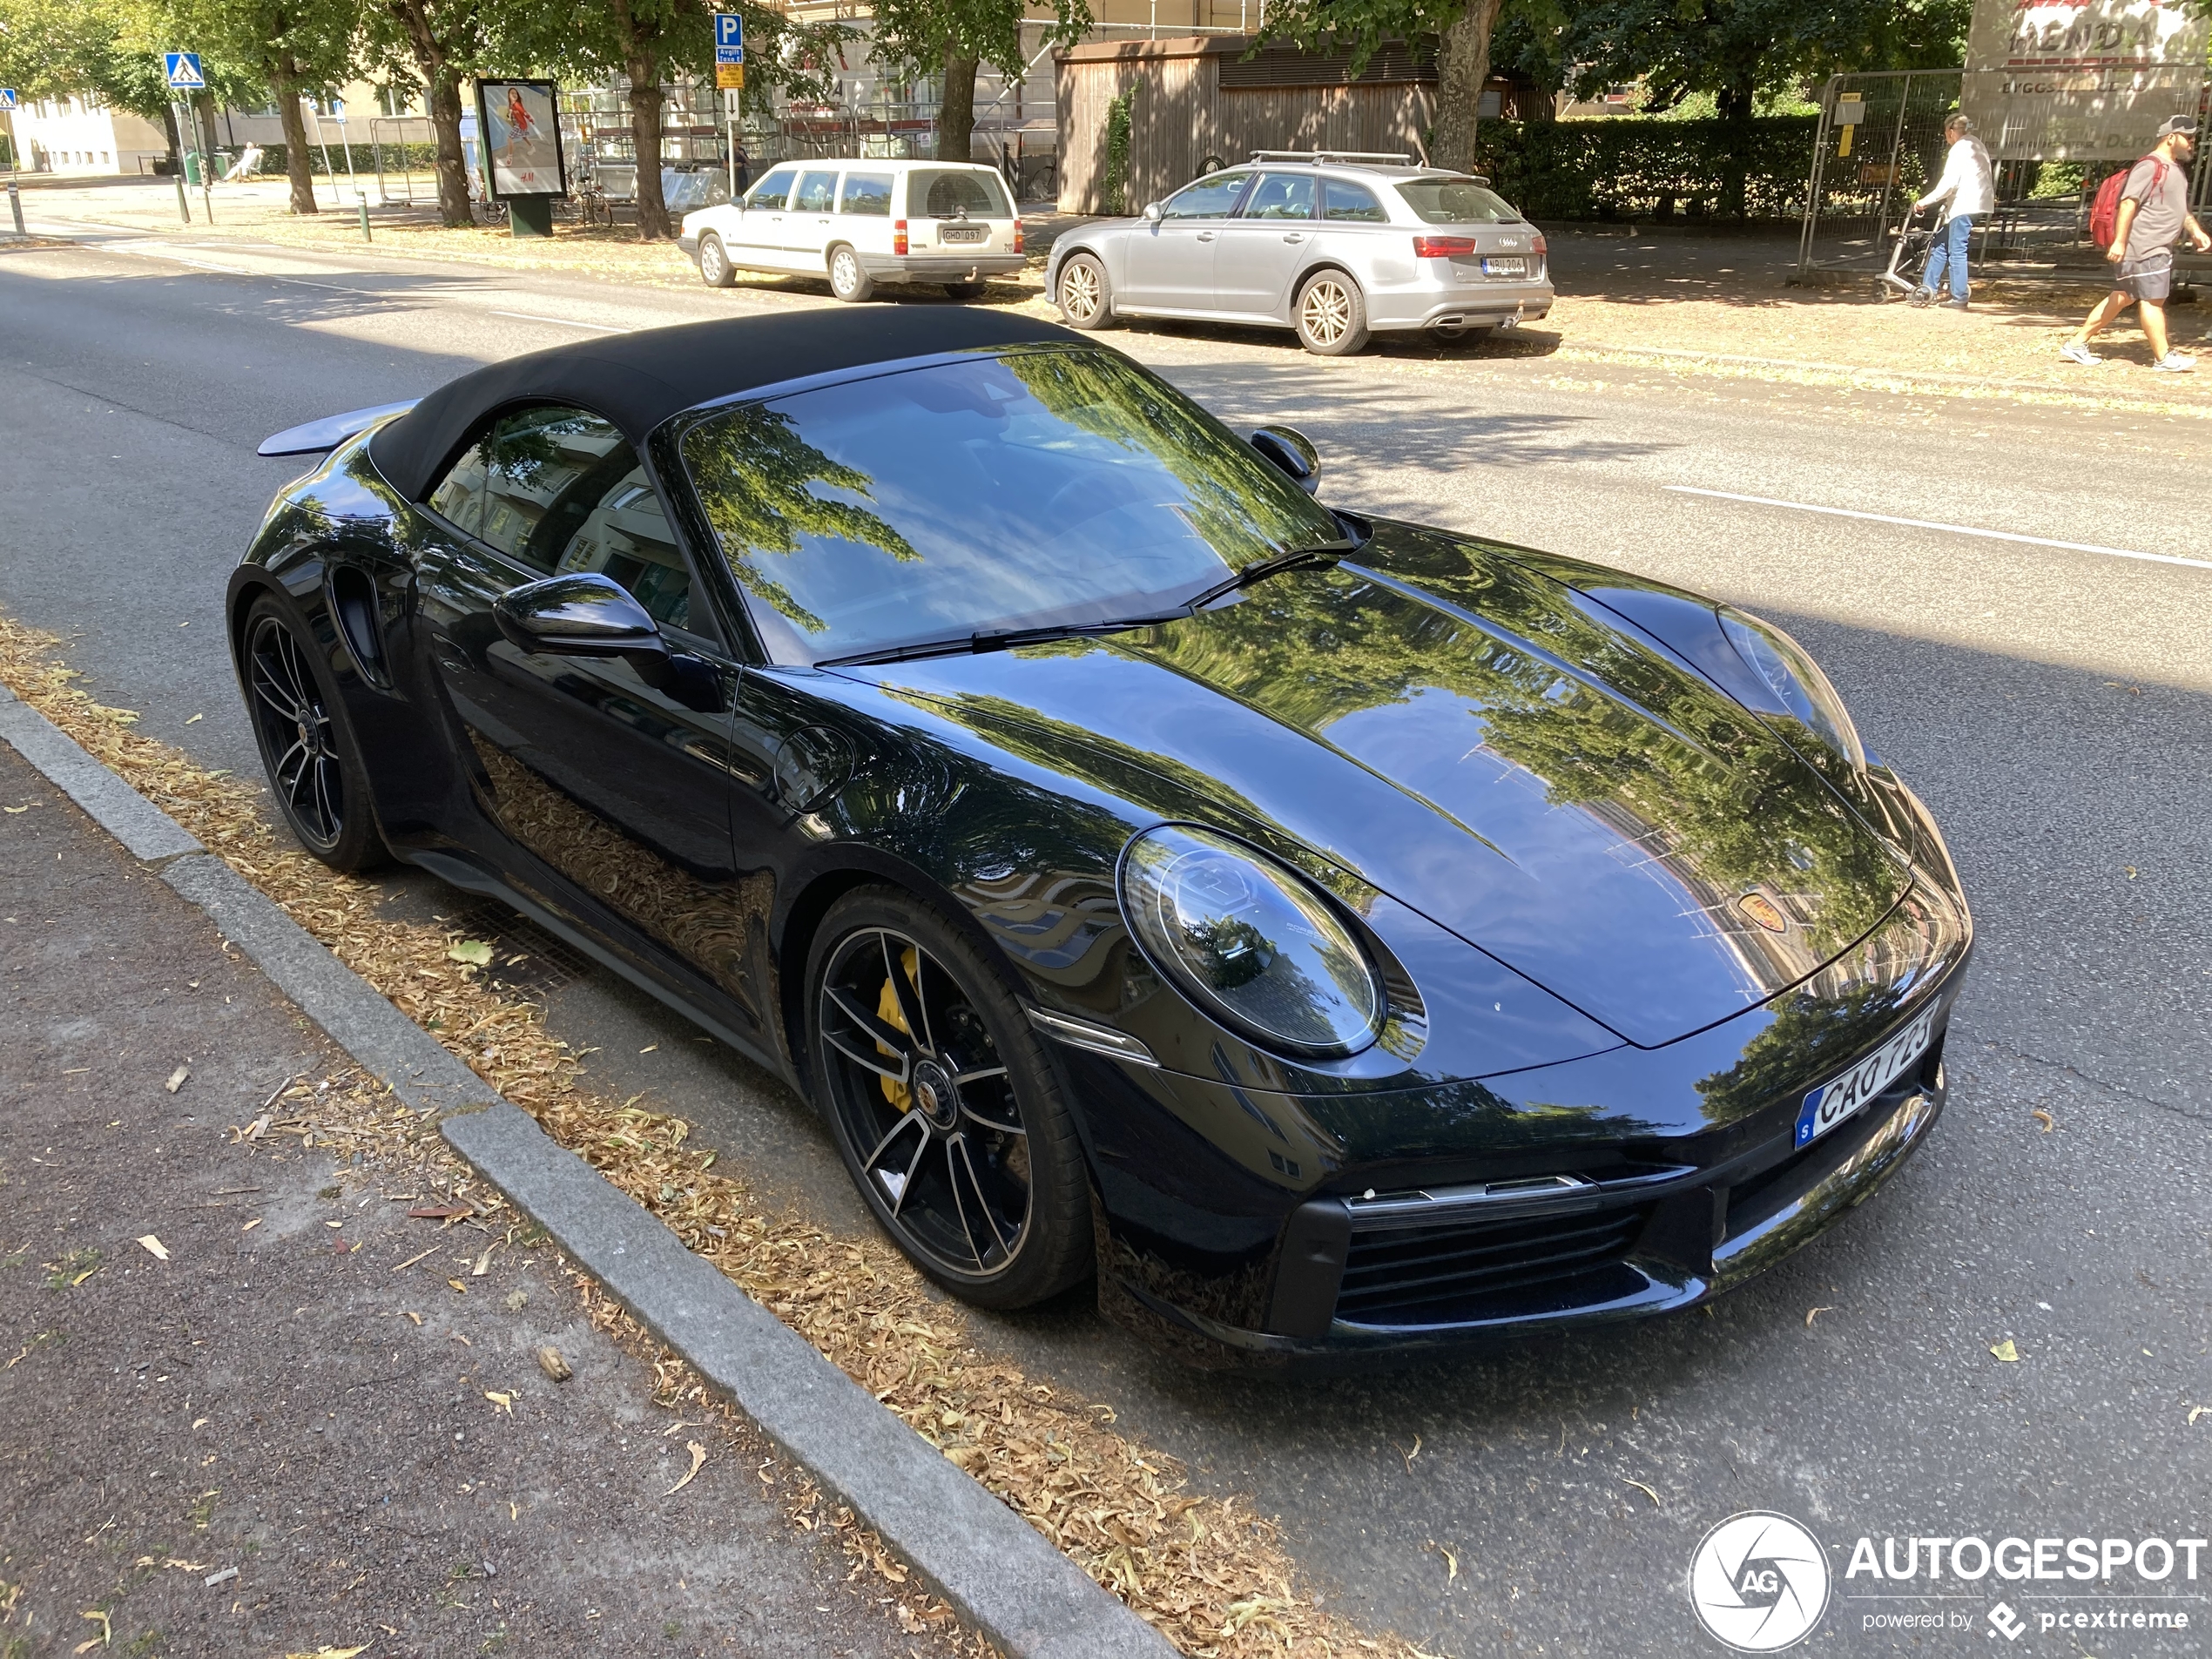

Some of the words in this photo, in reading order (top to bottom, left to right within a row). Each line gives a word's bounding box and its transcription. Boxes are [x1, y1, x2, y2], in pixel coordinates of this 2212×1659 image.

[722, 17, 738, 44] P
[720, 48, 739, 57] Avgift
[2106, 133, 2155, 149] Dero
[945, 231, 961, 240] GHD
[965, 231, 980, 240] 097
[1489, 259, 1506, 271] NBU
[1507, 259, 1521, 271] 206
[1885, 1006, 1936, 1080] 723
[1801, 1123, 1810, 1139] S
